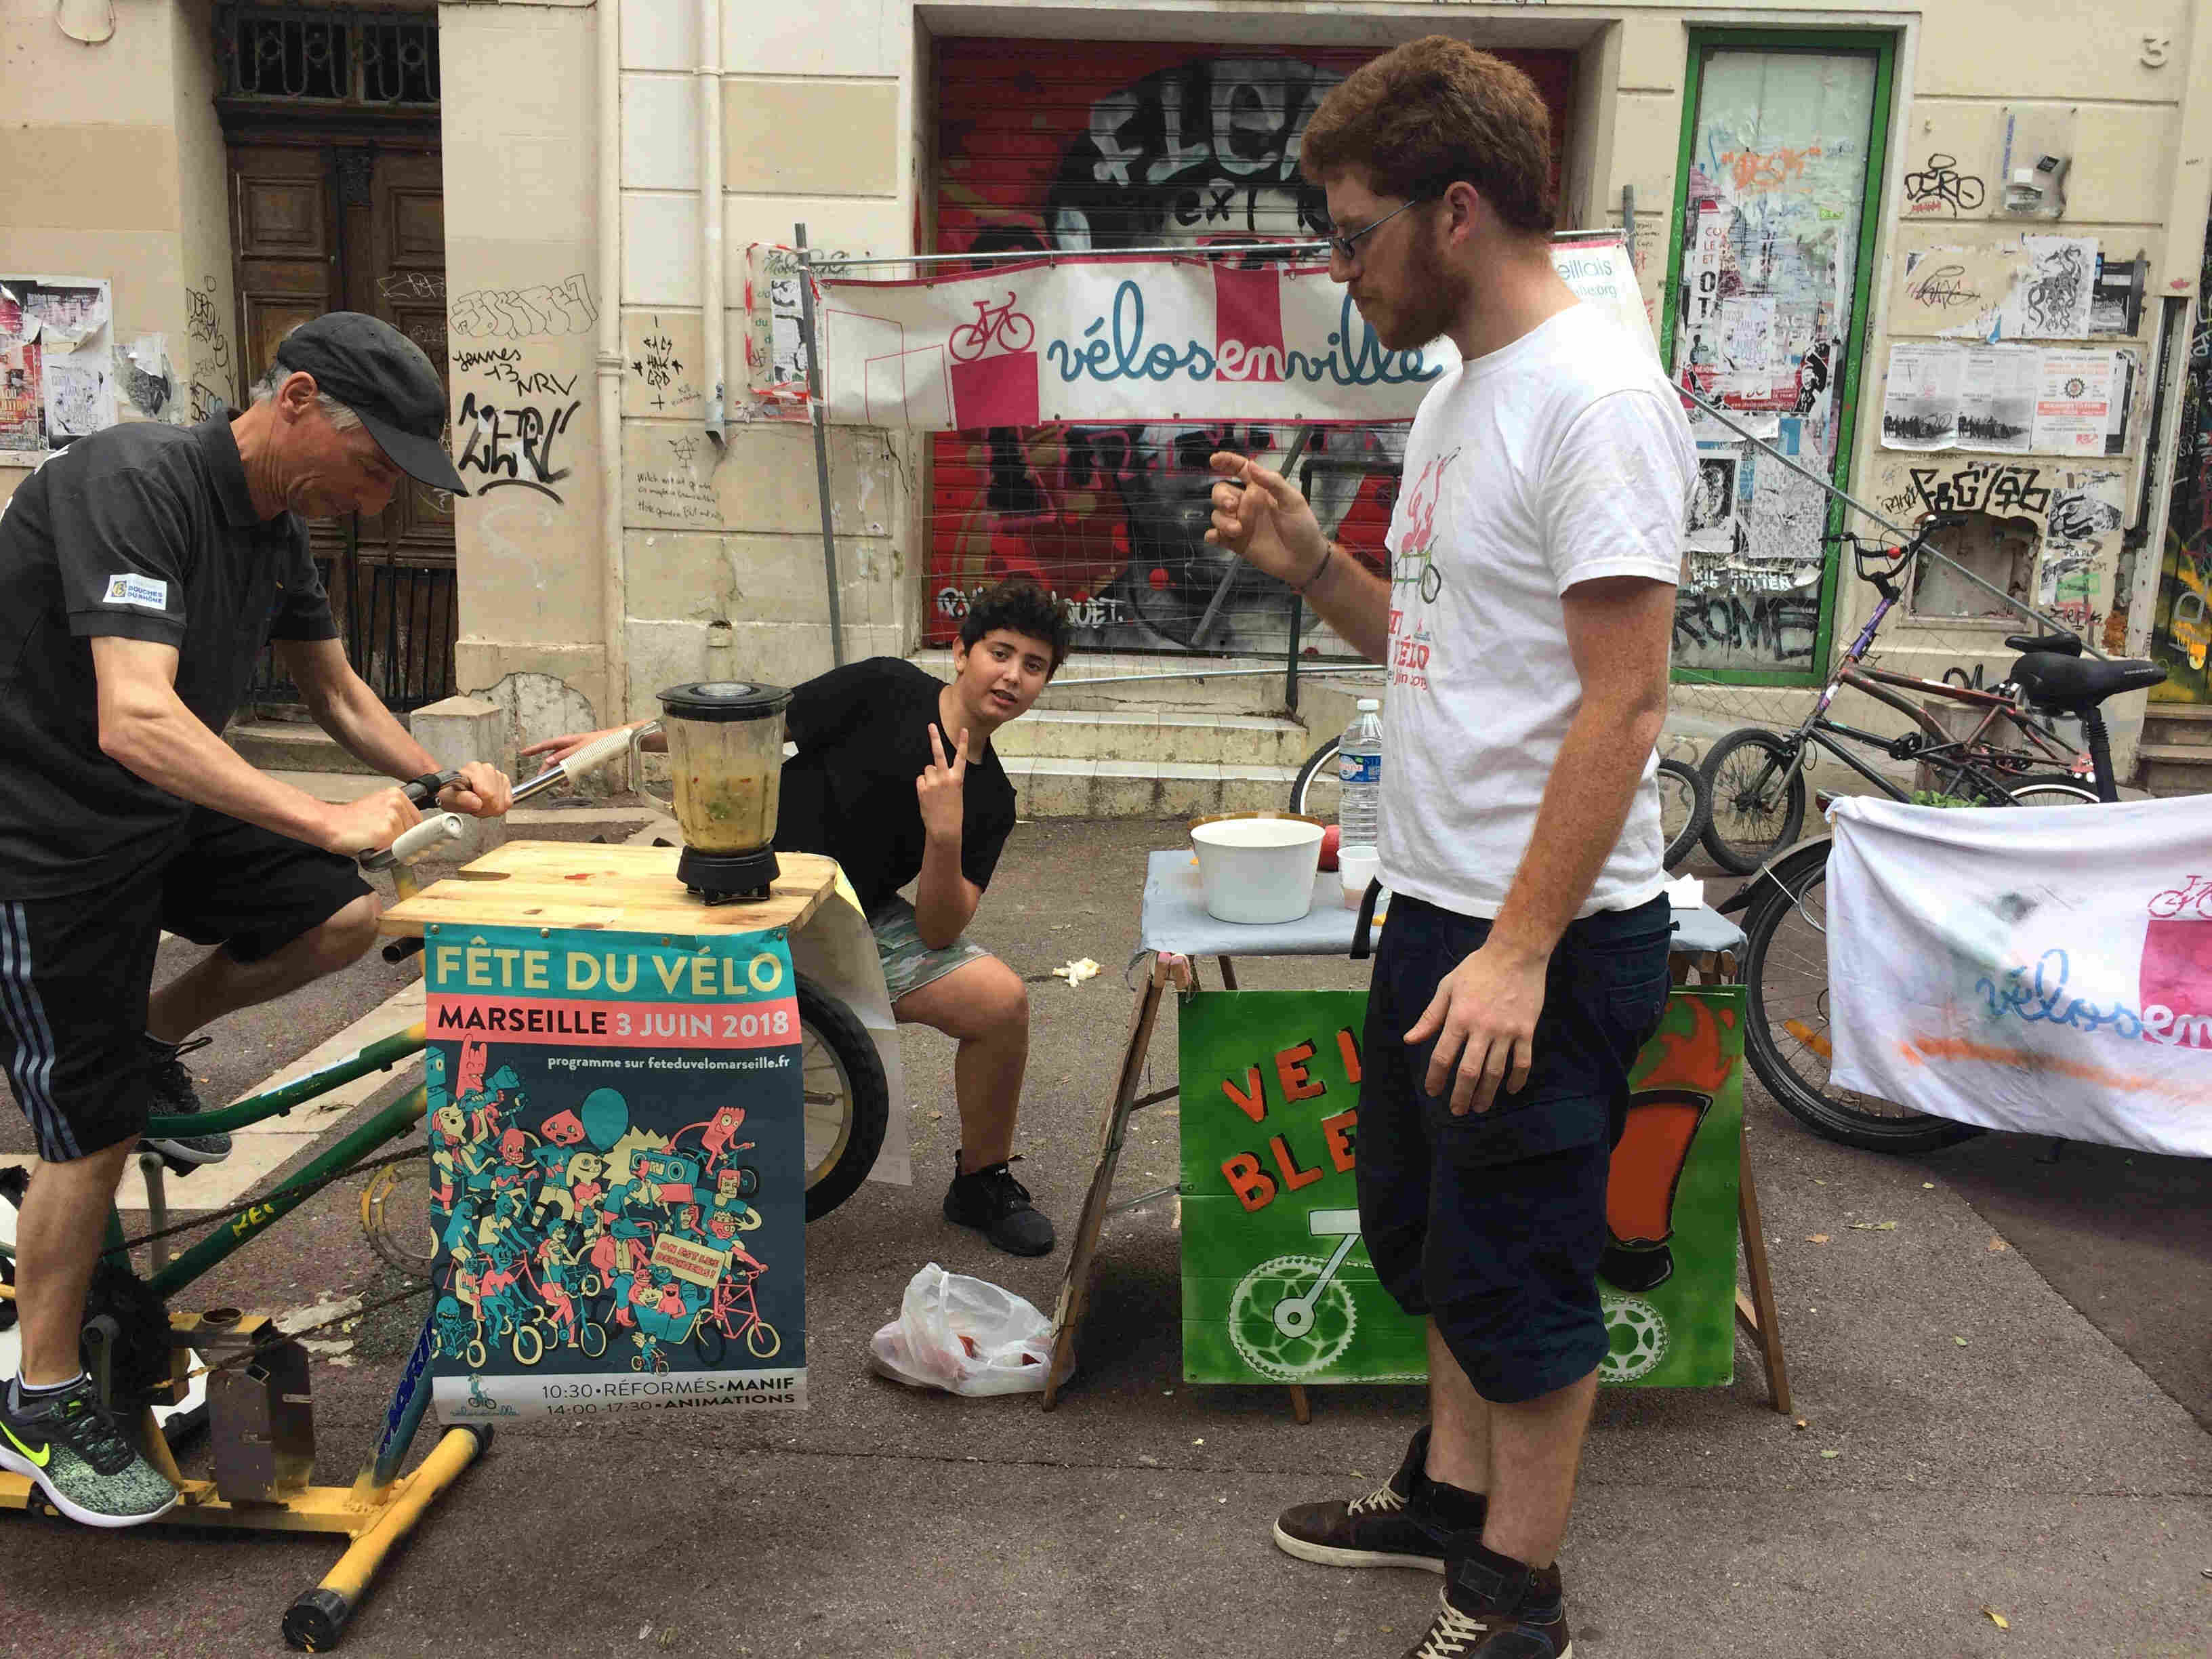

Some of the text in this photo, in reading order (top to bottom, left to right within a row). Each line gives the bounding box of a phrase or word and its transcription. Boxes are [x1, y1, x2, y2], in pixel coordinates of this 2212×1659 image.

[1556, 257, 1613, 281] eillais
[517, 373, 577, 397] NRV
[437, 935, 783, 996] FÊTE DU VÉLO
[438, 1004, 789, 1038] MARSEILLE 3 JUIN 2018
[548, 1054, 790, 1071] programme sur feteduvelomarseille.fr
[1220, 1105, 1358, 1213] BLE
[726, 1377, 794, 1391] MANIF
[665, 1394, 795, 1410] ANIMATIONS
